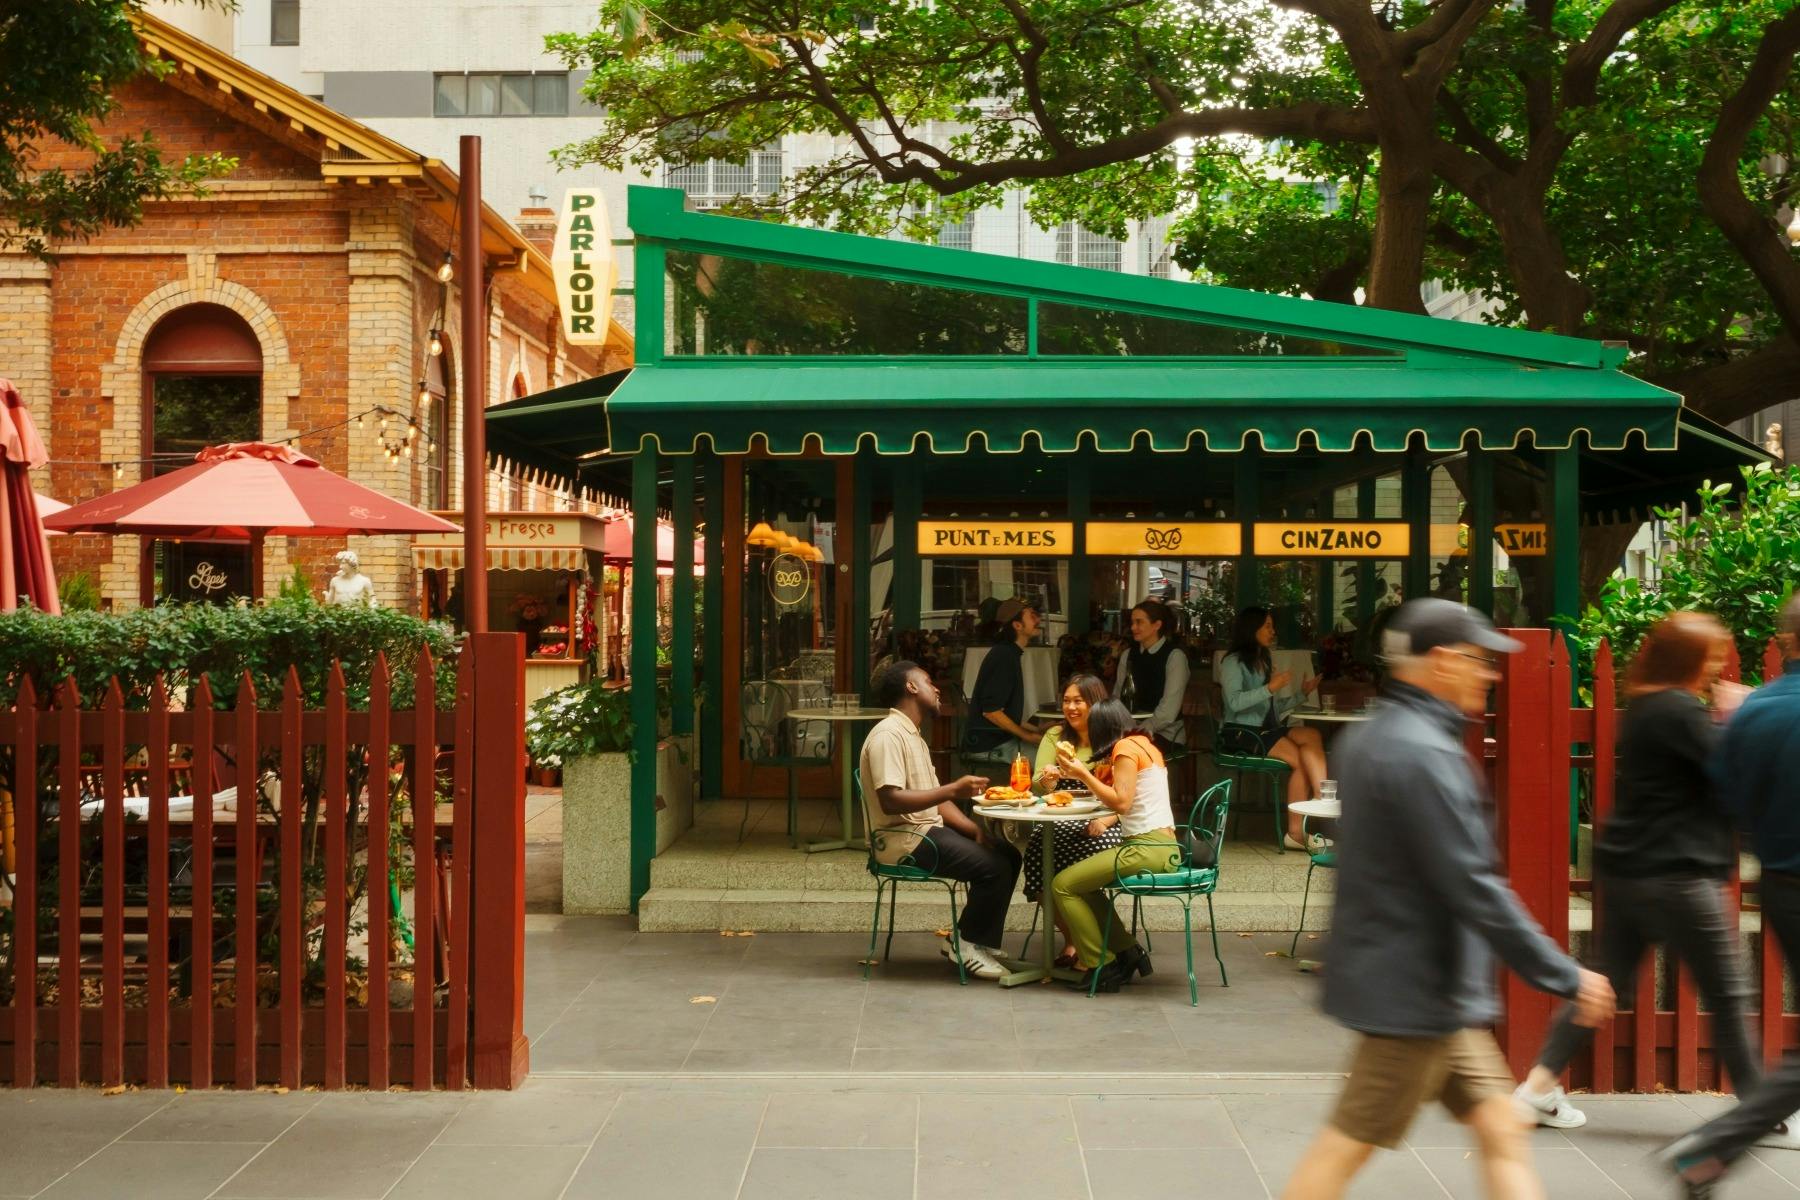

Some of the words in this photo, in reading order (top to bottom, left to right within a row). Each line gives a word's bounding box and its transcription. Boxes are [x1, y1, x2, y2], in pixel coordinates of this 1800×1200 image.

[569, 195, 596, 334] PARLOUR
[934, 529, 991, 546] PUNT
[1003, 530, 1056, 547] MES
[1281, 528, 1382, 550] CINZANO
